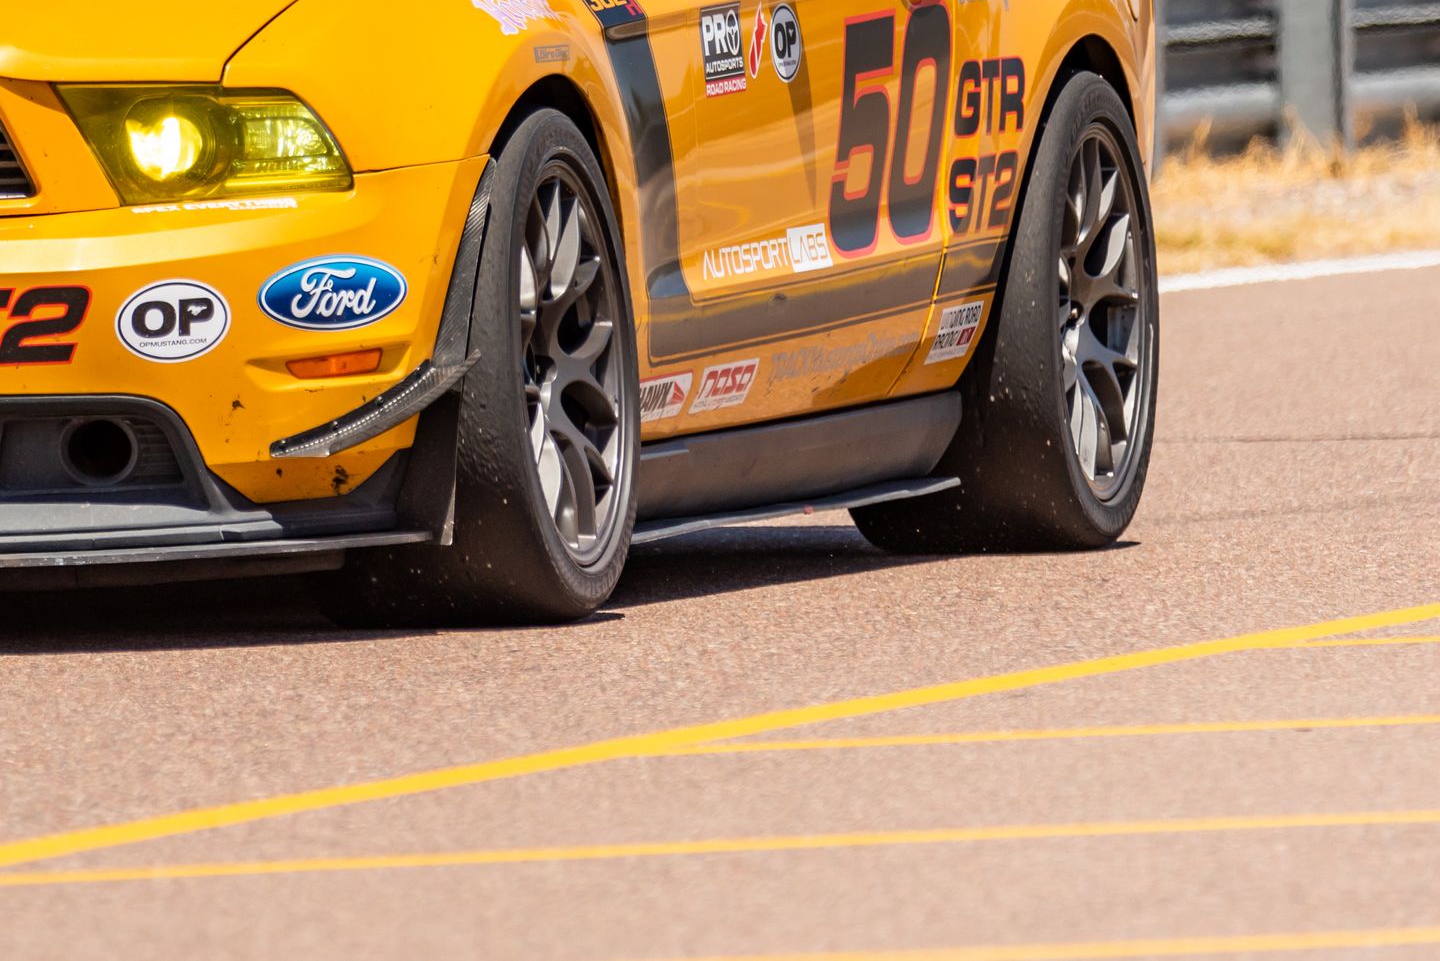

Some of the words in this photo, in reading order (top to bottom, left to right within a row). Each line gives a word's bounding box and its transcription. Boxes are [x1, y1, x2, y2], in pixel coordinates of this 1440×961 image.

[774, 21, 797, 59] OP
[706, 57, 744, 74] AUTOSPORTS
[706, 83, 724, 95] ROAD
[724, 78, 747, 93] RACING
[953, 56, 1026, 139] GTR
[948, 150, 1019, 238] ST2
[703, 239, 789, 280] AUTOSPORT
[791, 233, 829, 269] LABS
[290, 268, 377, 318] Ford
[131, 296, 216, 338] OP
[139, 338, 208, 348] OPMUSTANG.COM
[698, 365, 757, 399] nasa
